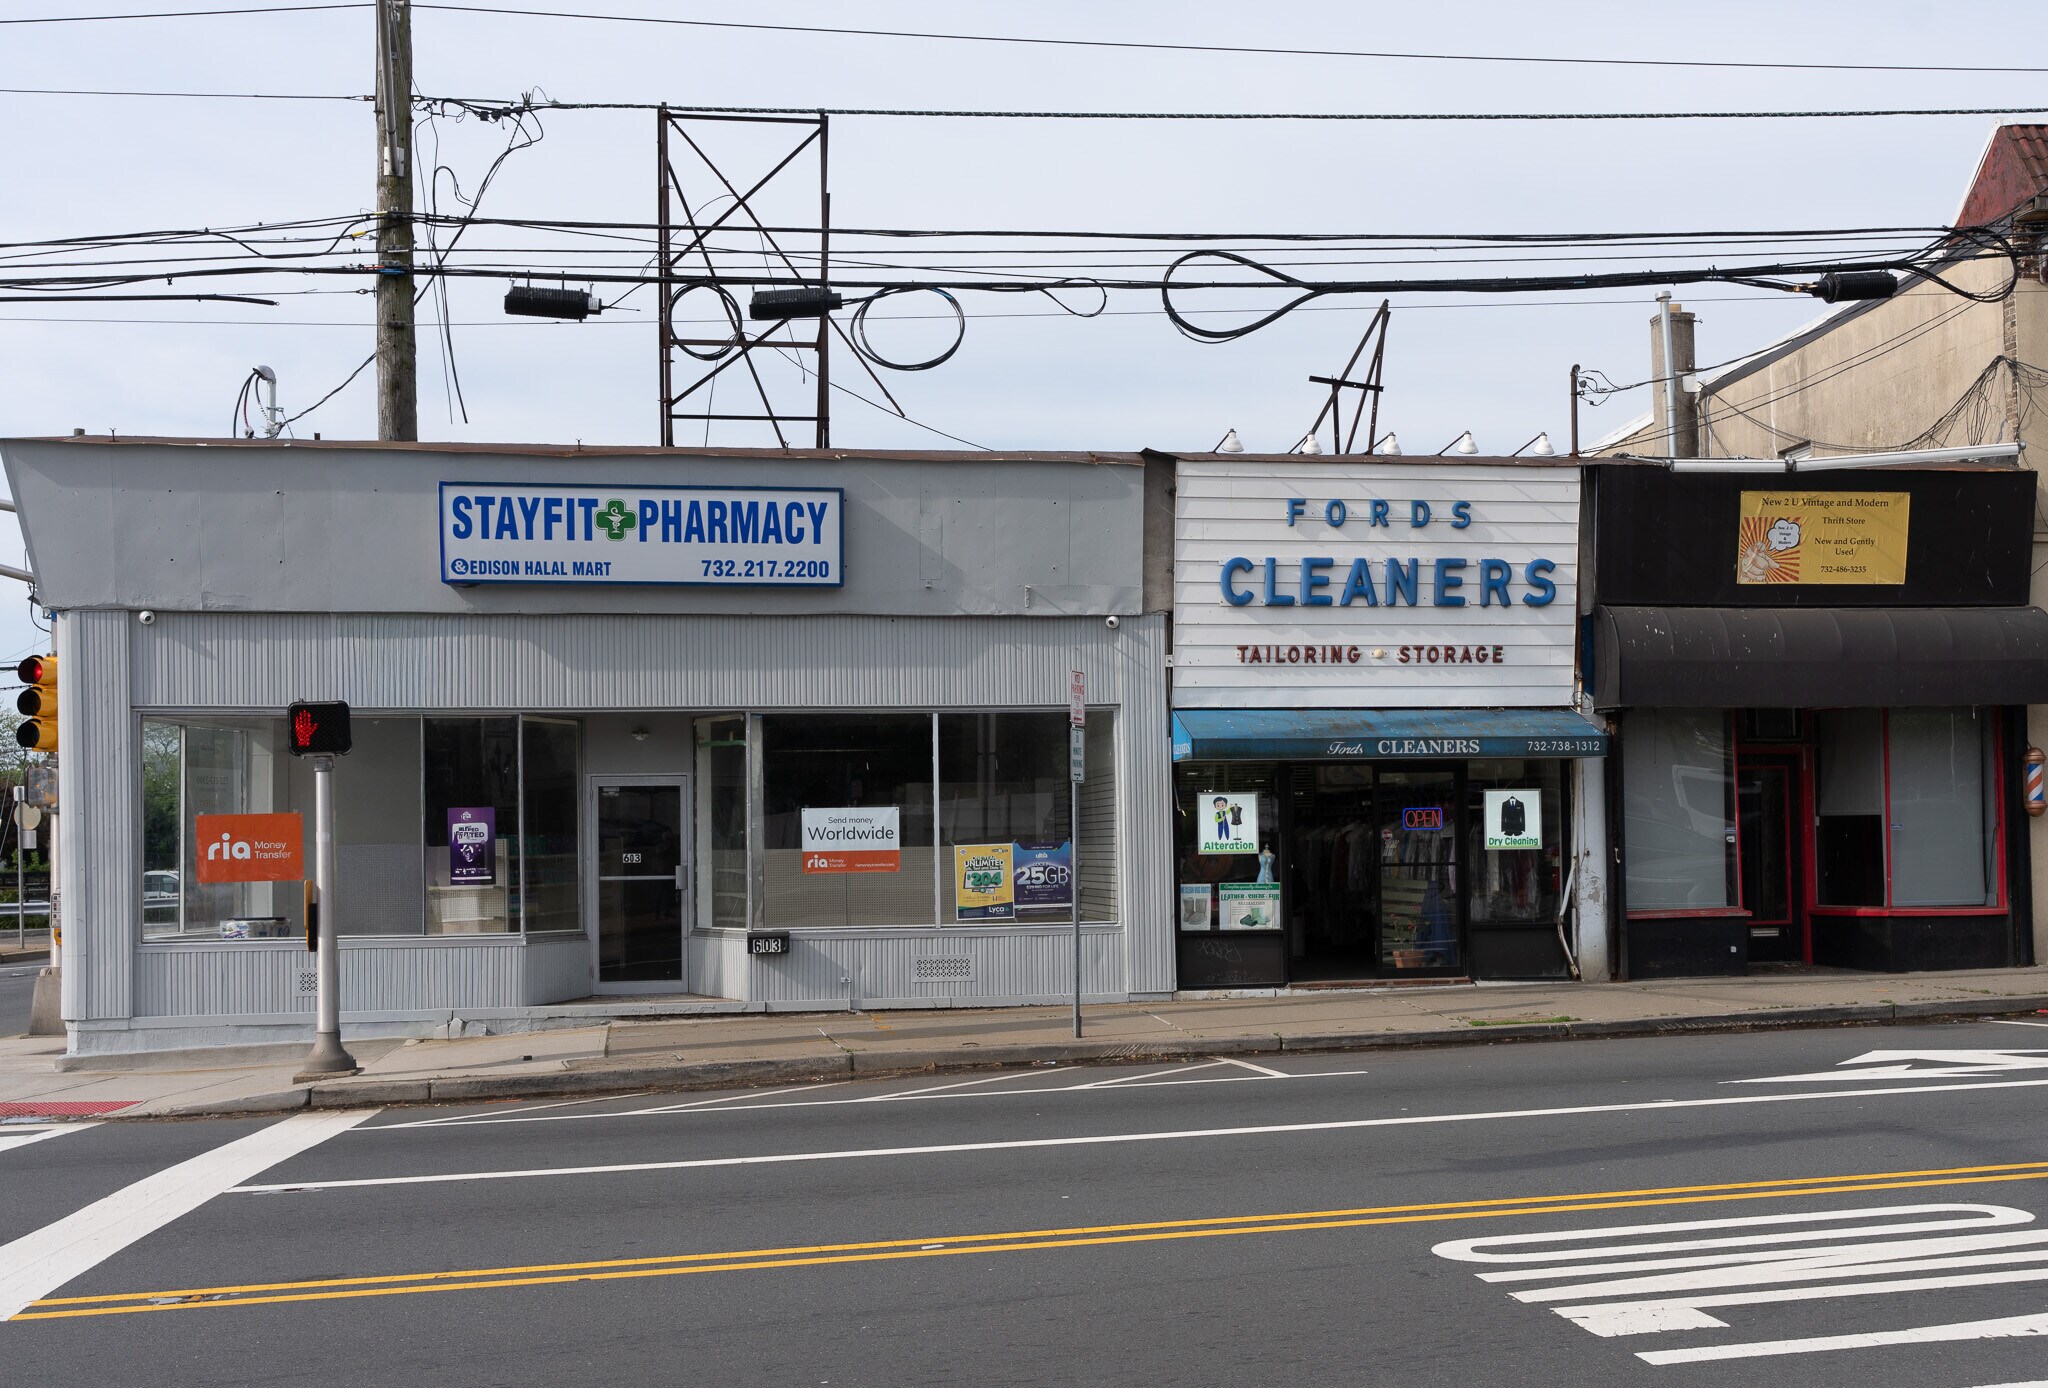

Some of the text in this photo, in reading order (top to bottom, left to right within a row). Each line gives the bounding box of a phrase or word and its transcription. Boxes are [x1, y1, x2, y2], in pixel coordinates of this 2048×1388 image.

[1762, 498, 1889, 509] New 2 U Vintage and Modern
[452, 496, 828, 544] STAYFIT PHARMACY
[1287, 498, 1472, 528] FORDS
[1850, 538, 1876, 546] Gently
[470, 560, 522, 576] EDISON
[525, 560, 570, 576] HALAL
[573, 561, 611, 576] MART
[701, 560, 830, 578] 732.217.2200
[1220, 557, 1557, 608] CLEANERS
[1236, 644, 1504, 664] TAILORING STORAGE
[1377, 740, 1480, 754] CLEANERS
[1527, 741, 1600, 751] 732-738-1312
[1406, 810, 1440, 827] OPEN
[808, 826, 894, 840] Worldwide
[208, 832, 286, 860] ria Money
[1204, 842, 1254, 850] Alteration
[1489, 837, 1538, 846] Dry Cleaning
[255, 851, 291, 859] Transfer
[624, 854, 640, 862] 603
[807, 854, 828, 868] ria
[967, 872, 1002, 886] $204
[1016, 866, 1068, 884] 25GB
[754, 940, 781, 952] 603
